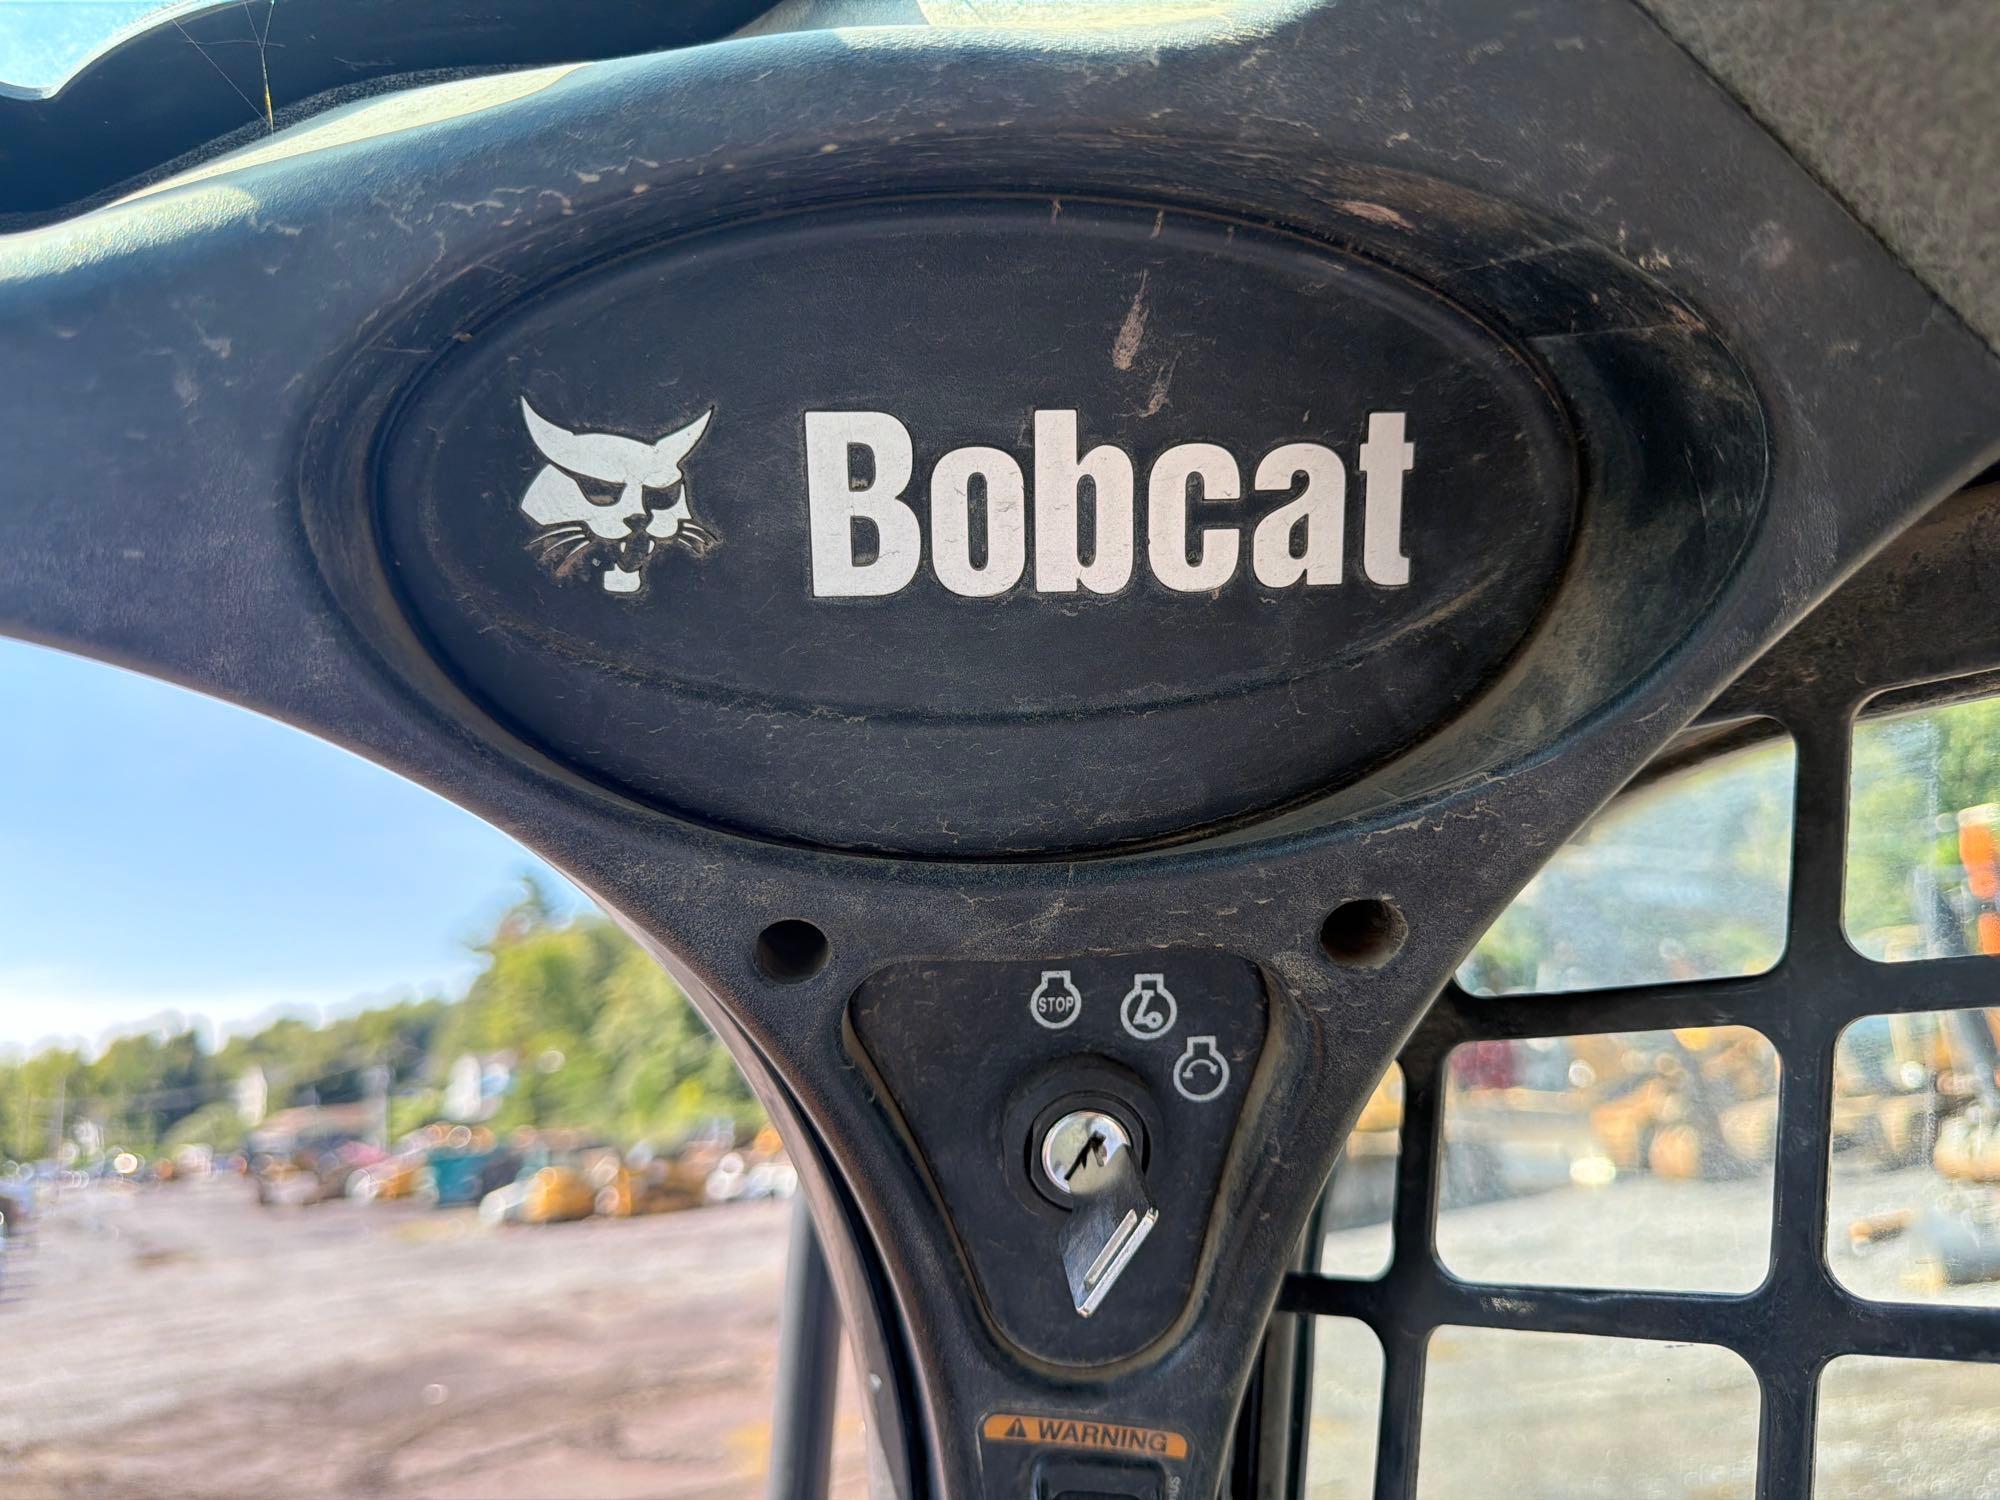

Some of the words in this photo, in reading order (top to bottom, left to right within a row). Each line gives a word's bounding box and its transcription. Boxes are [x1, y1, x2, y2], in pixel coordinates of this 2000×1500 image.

[804, 409, 1414, 598] Bobcat
[1038, 996, 1074, 1013] STOP
[1038, 1419, 1167, 1452] WARNING
